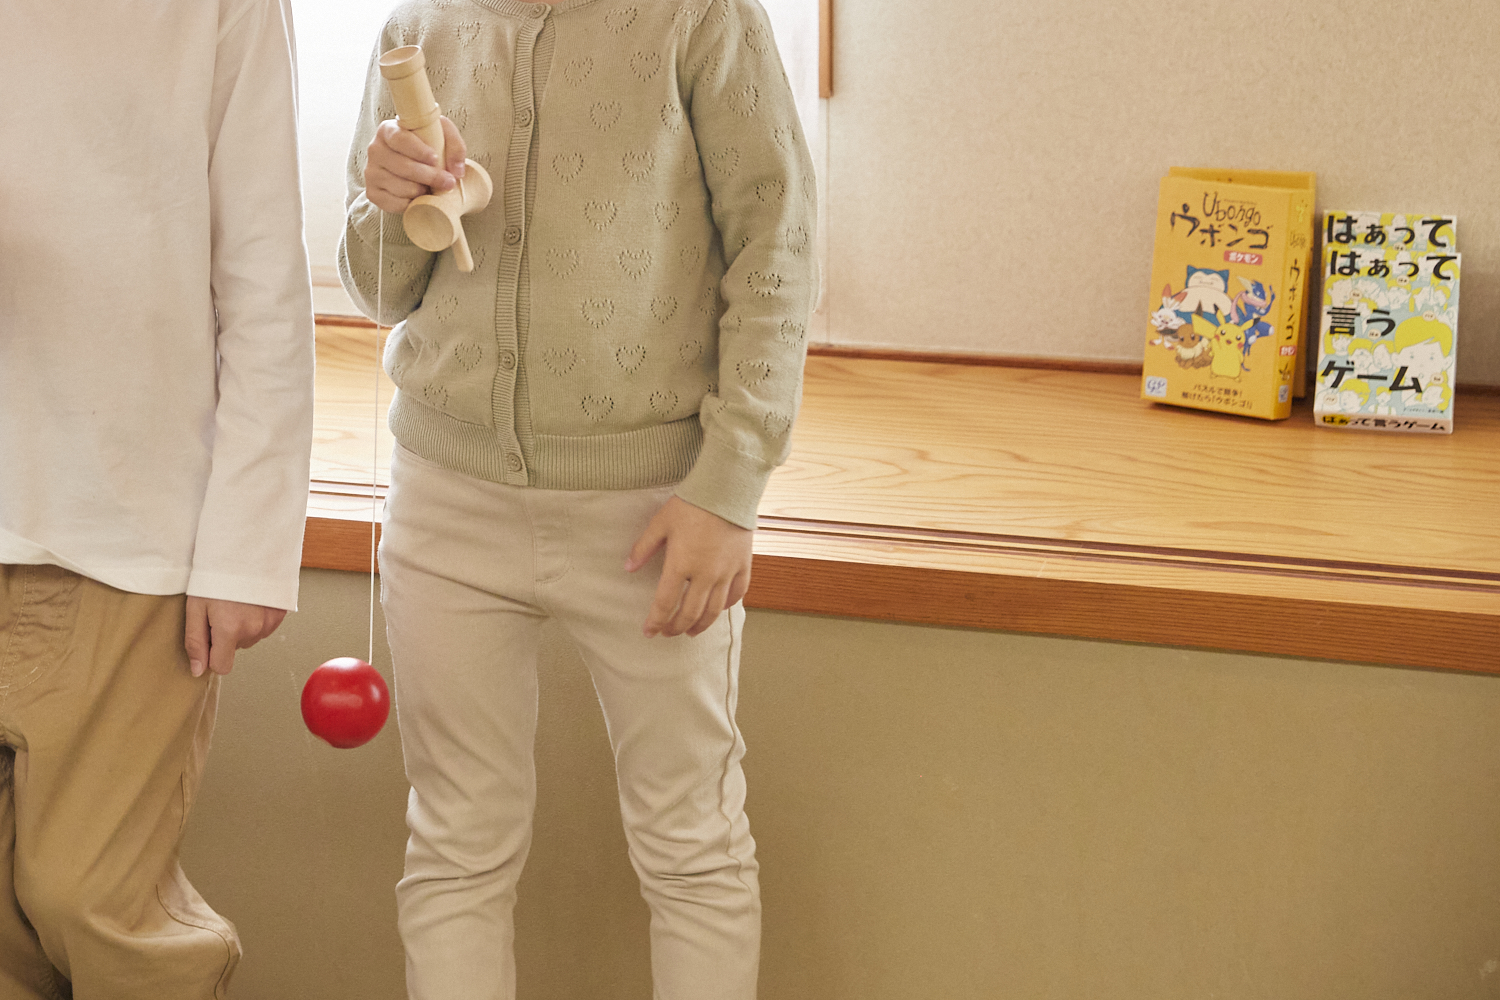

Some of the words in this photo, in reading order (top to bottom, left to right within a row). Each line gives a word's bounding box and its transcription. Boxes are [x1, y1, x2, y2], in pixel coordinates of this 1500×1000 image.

[1170, 203, 1273, 249] ウボンゴ
[1203, 191, 1261, 228] Ubongo
[1327, 215, 1453, 248] はぁって
[1228, 251, 1259, 265] ポケモン
[1330, 250, 1458, 280] はぁって
[1326, 306, 1396, 336] 言う
[1321, 360, 1423, 393] ゲーム
